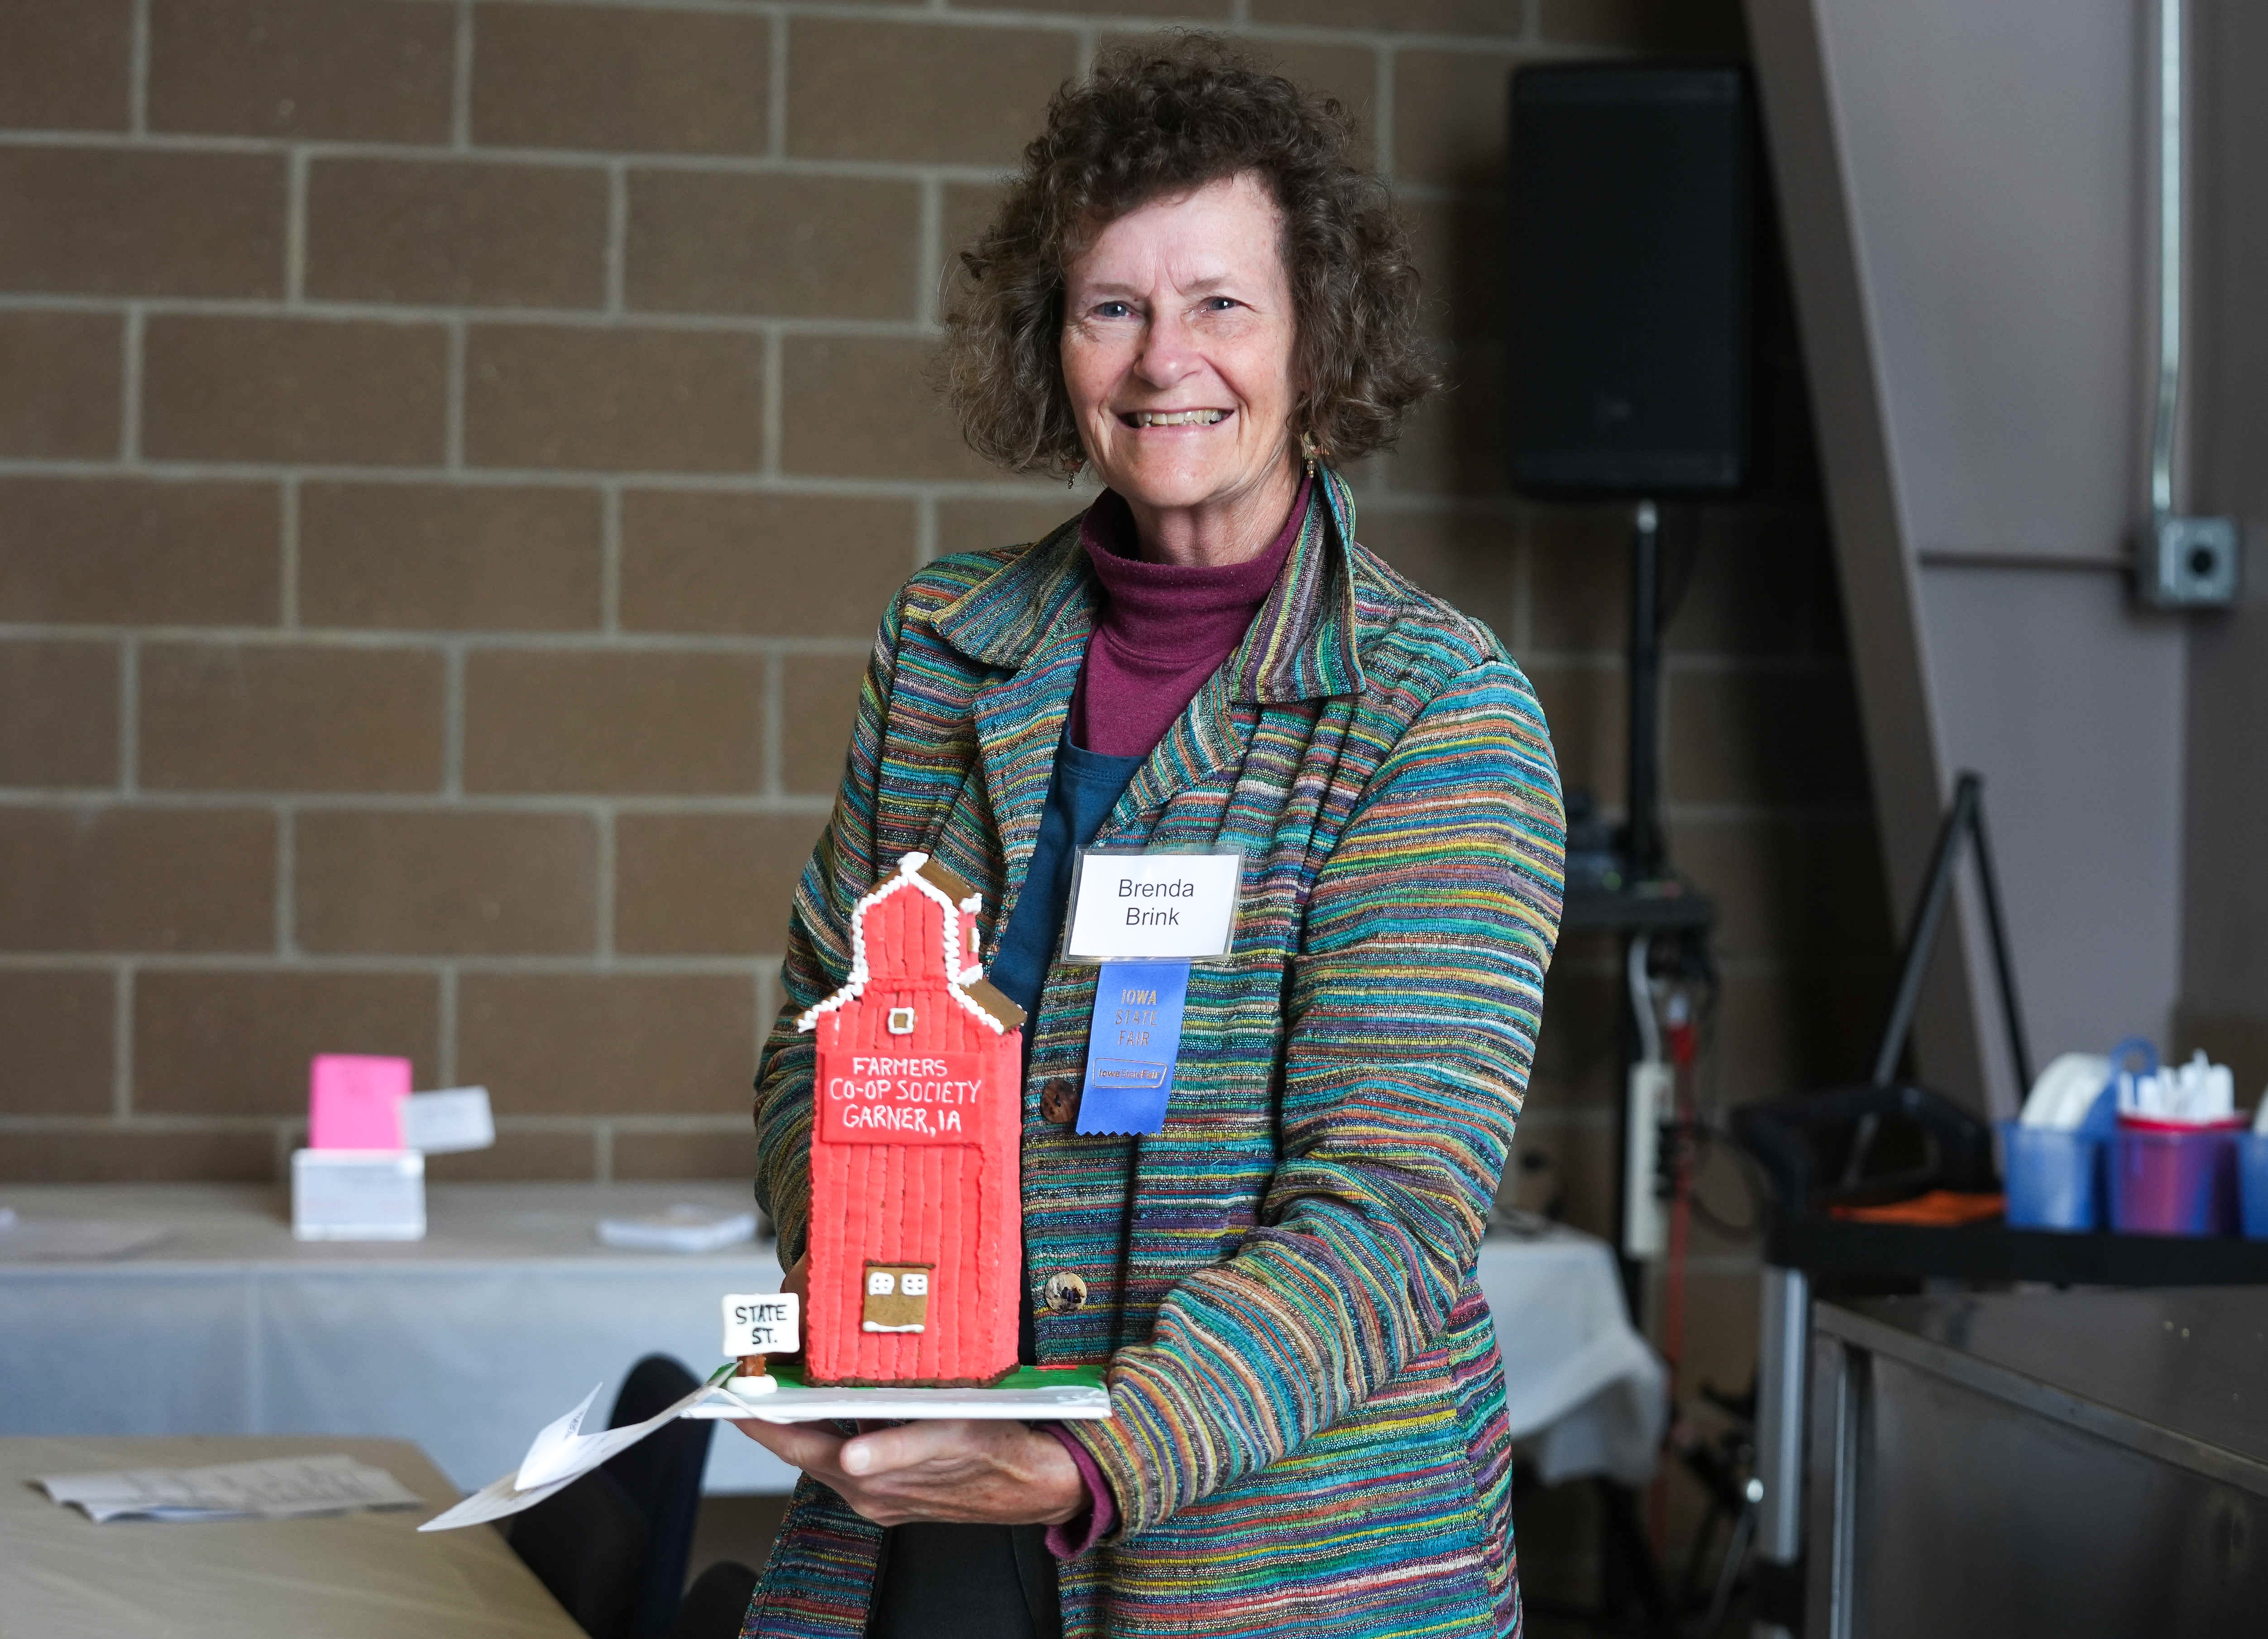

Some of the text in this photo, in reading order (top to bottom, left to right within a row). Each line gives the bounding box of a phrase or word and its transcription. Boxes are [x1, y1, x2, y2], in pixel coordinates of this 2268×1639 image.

[1118, 879, 1194, 897] Brenda
[1125, 907, 1180, 926] Brink
[1121, 989, 1157, 1005] IOWA
[1115, 1009, 1158, 1026] STATE
[1118, 1030, 1150, 1047] FAIR
[853, 1057, 947, 1077] FARMERS
[830, 1078, 982, 1104] CO-OP SOCIETY
[842, 1104, 962, 1137] GARNER, IA
[735, 1304, 788, 1324] STATE
[751, 1327, 778, 1345] ST.
